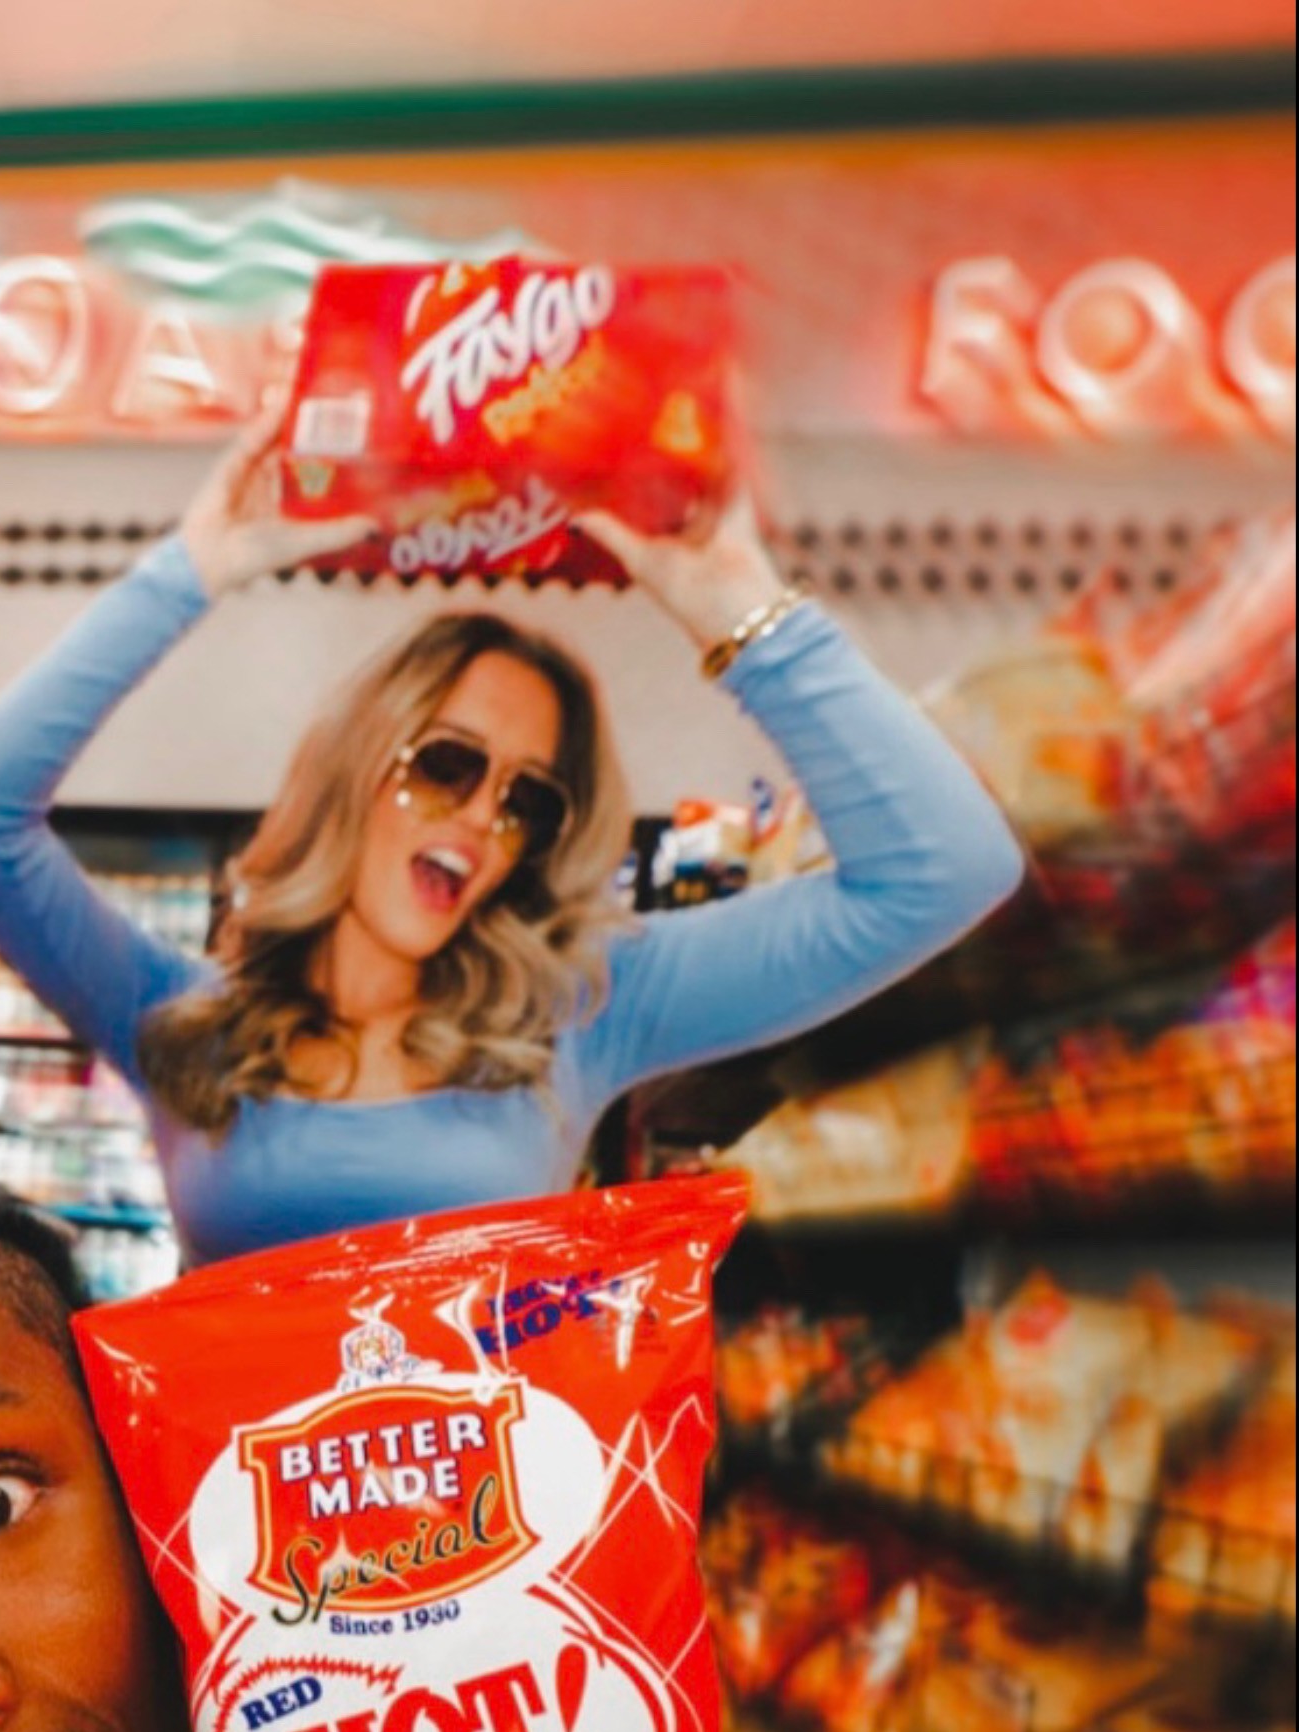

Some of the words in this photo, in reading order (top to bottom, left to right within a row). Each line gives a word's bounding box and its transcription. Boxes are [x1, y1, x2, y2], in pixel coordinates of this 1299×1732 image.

[399, 264, 616, 446] Faygo
[277, 1411, 487, 1483] BETTER
[307, 1457, 463, 1521] MADE
[271, 1472, 513, 1627] Special
[329, 1613, 395, 1636] Since
[403, 1598, 462, 1633] 1930
[239, 1675, 324, 1732] RED
